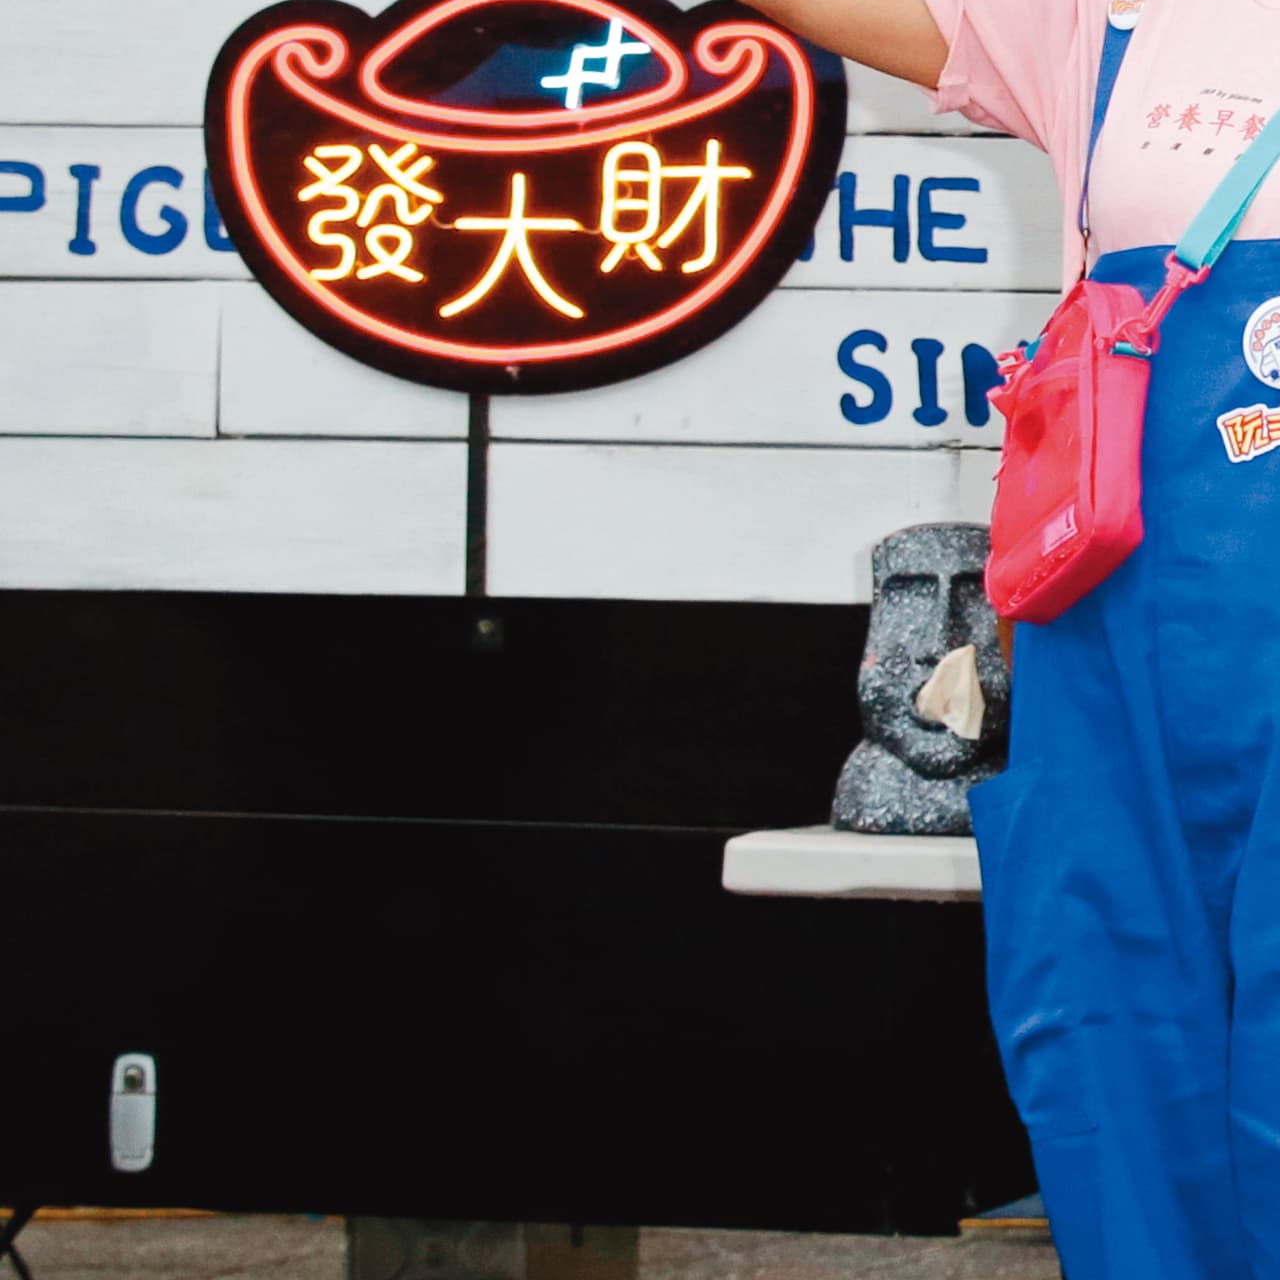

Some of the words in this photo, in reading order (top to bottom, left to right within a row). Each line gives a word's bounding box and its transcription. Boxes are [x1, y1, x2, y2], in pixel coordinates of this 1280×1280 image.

[0, 160, 238, 256] PIG
[798, 171, 988, 263] HE
[296, 139, 752, 321] 發大財
